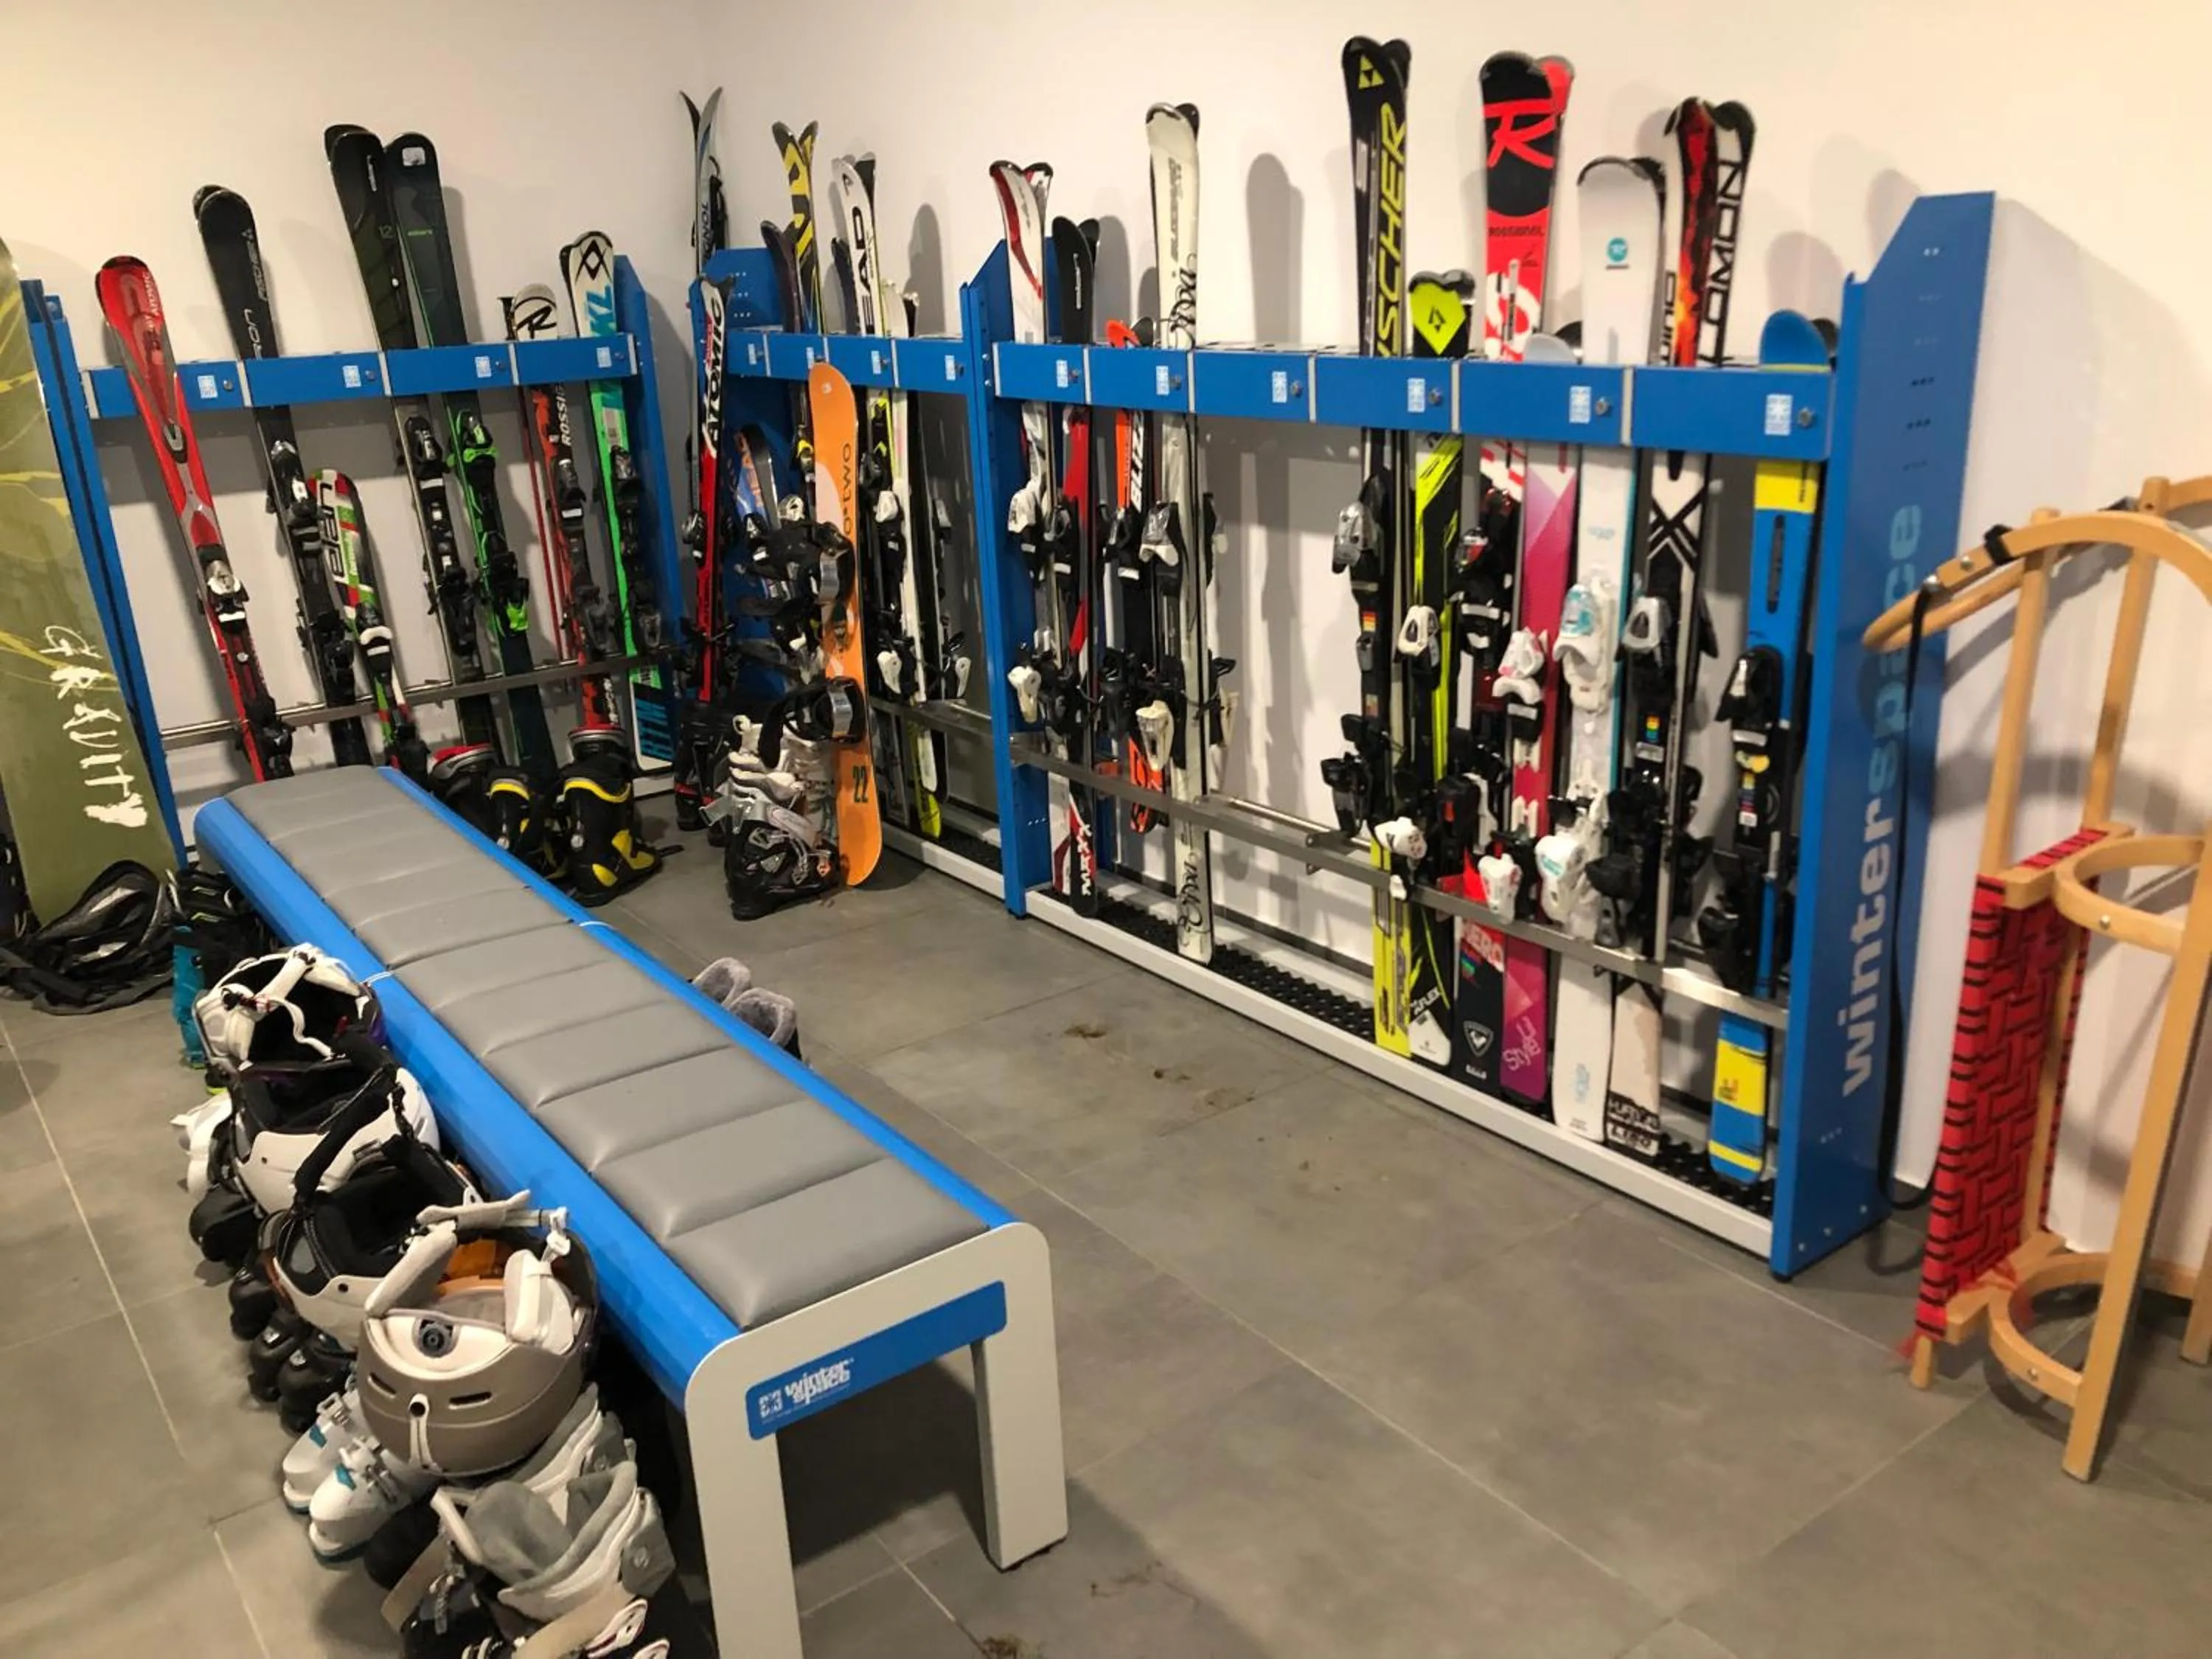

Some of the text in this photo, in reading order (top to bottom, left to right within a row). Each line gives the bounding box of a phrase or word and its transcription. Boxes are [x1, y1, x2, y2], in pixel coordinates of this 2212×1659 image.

[853, 206, 874, 335] EAD
[1377, 102, 1408, 358] ISCHER
[1698, 158, 1742, 363] LOMON
[244, 308, 262, 360] RON
[585, 282, 616, 337] KL
[555, 386, 572, 447] ROSSIG
[1130, 411, 1144, 512] BLIZZ
[39, 625, 147, 827] GRAVITY
[852, 765, 869, 803] 22
